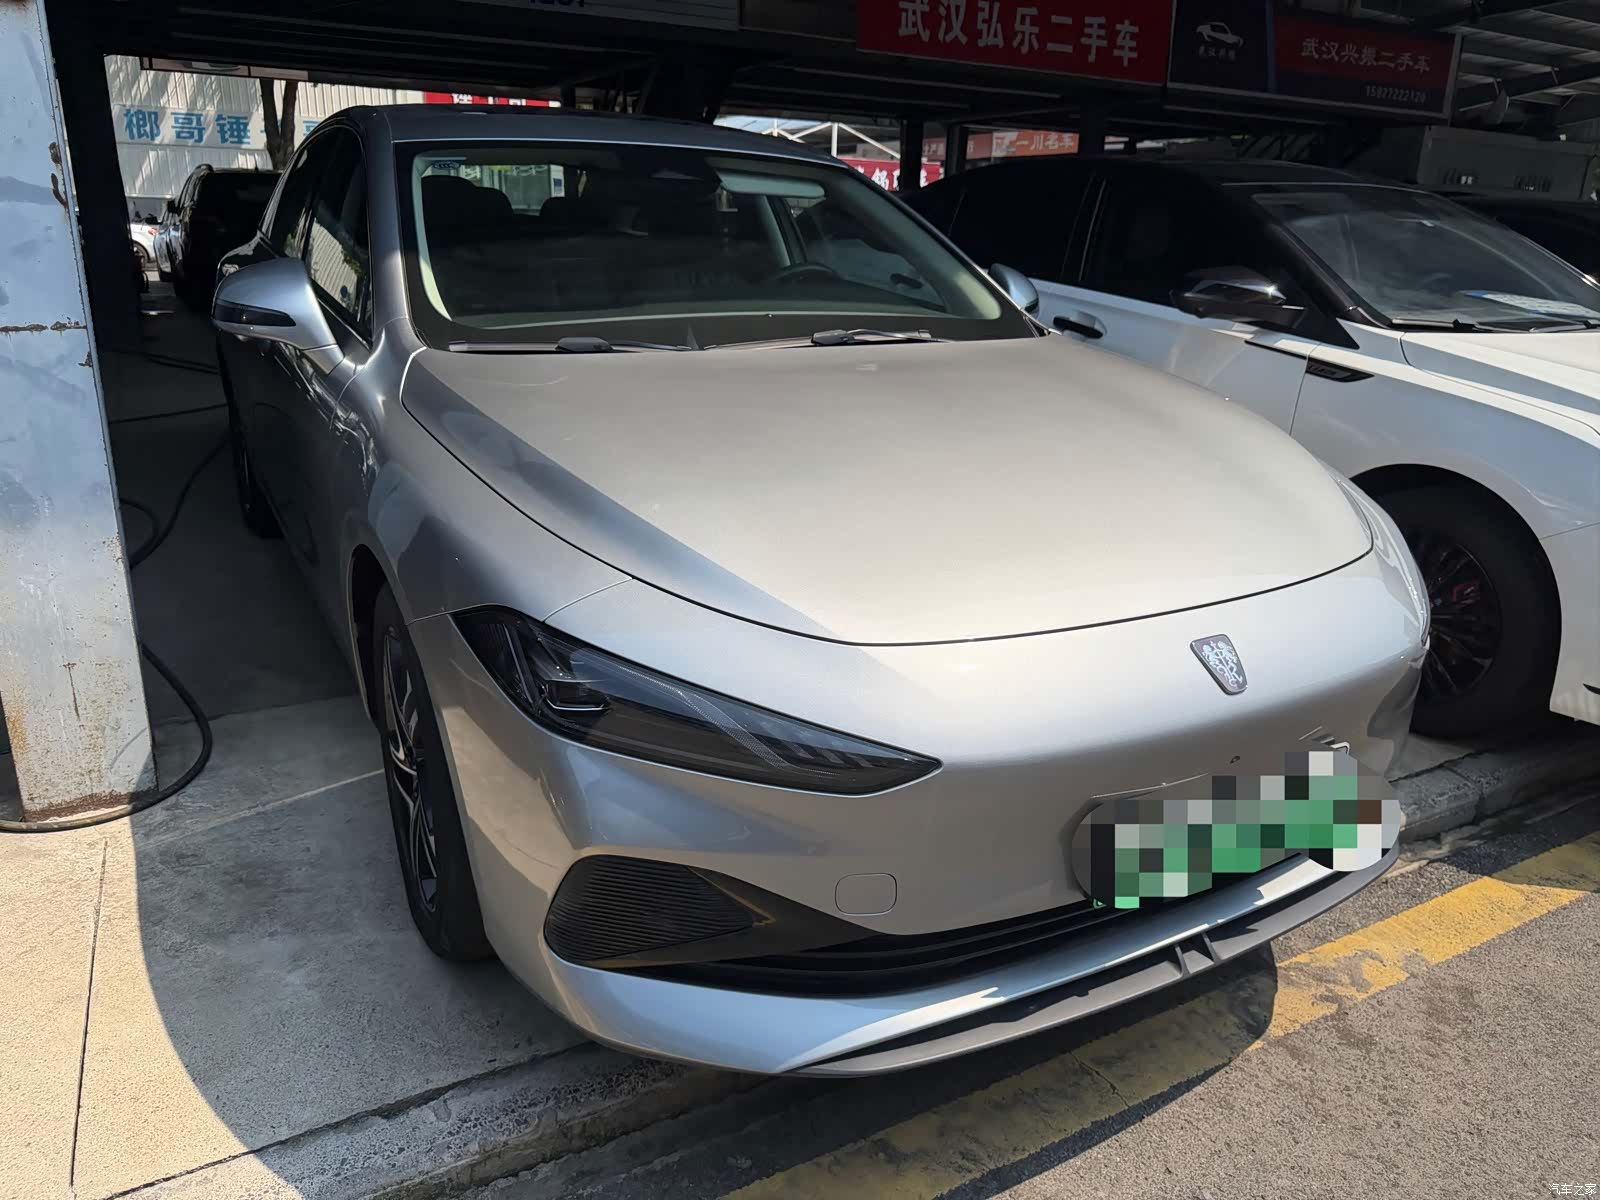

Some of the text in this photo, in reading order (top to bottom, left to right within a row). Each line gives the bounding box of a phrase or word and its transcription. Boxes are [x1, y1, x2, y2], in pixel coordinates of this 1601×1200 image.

[897, 0, 1139, 67] 武汉弘乐二手车
[1301, 36, 1431, 73] 武汉兴振二手车
[123, 108, 321, 145] 榔哥锤
